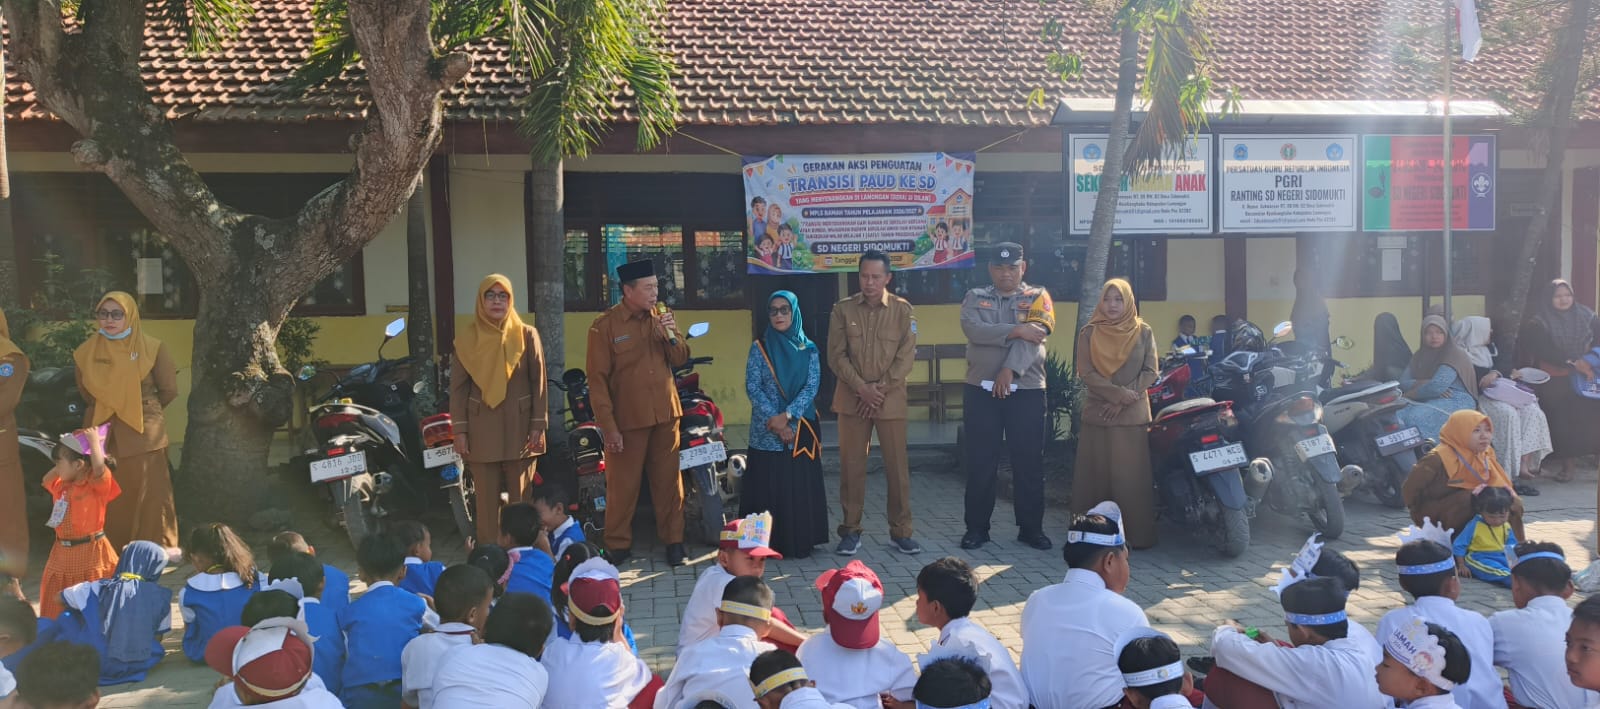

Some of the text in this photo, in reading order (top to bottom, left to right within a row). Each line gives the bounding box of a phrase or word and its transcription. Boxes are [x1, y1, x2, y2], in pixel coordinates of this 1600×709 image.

[803, 160, 922, 172] GERAKAN AKSI PENGUATAN
[788, 174, 936, 193] TRANSISI PAUD KE SD
[1175, 173, 1206, 192] ANAK
[1275, 174, 1303, 188] PGRI
[1231, 188, 1346, 201] RANTING SD NEGERI SIDOMUKTI
[817, 242, 909, 252] SD NEGERI SIDOMUKTI
[834, 256, 857, 264] Tanggal
[1192, 454, 1199, 463] S
